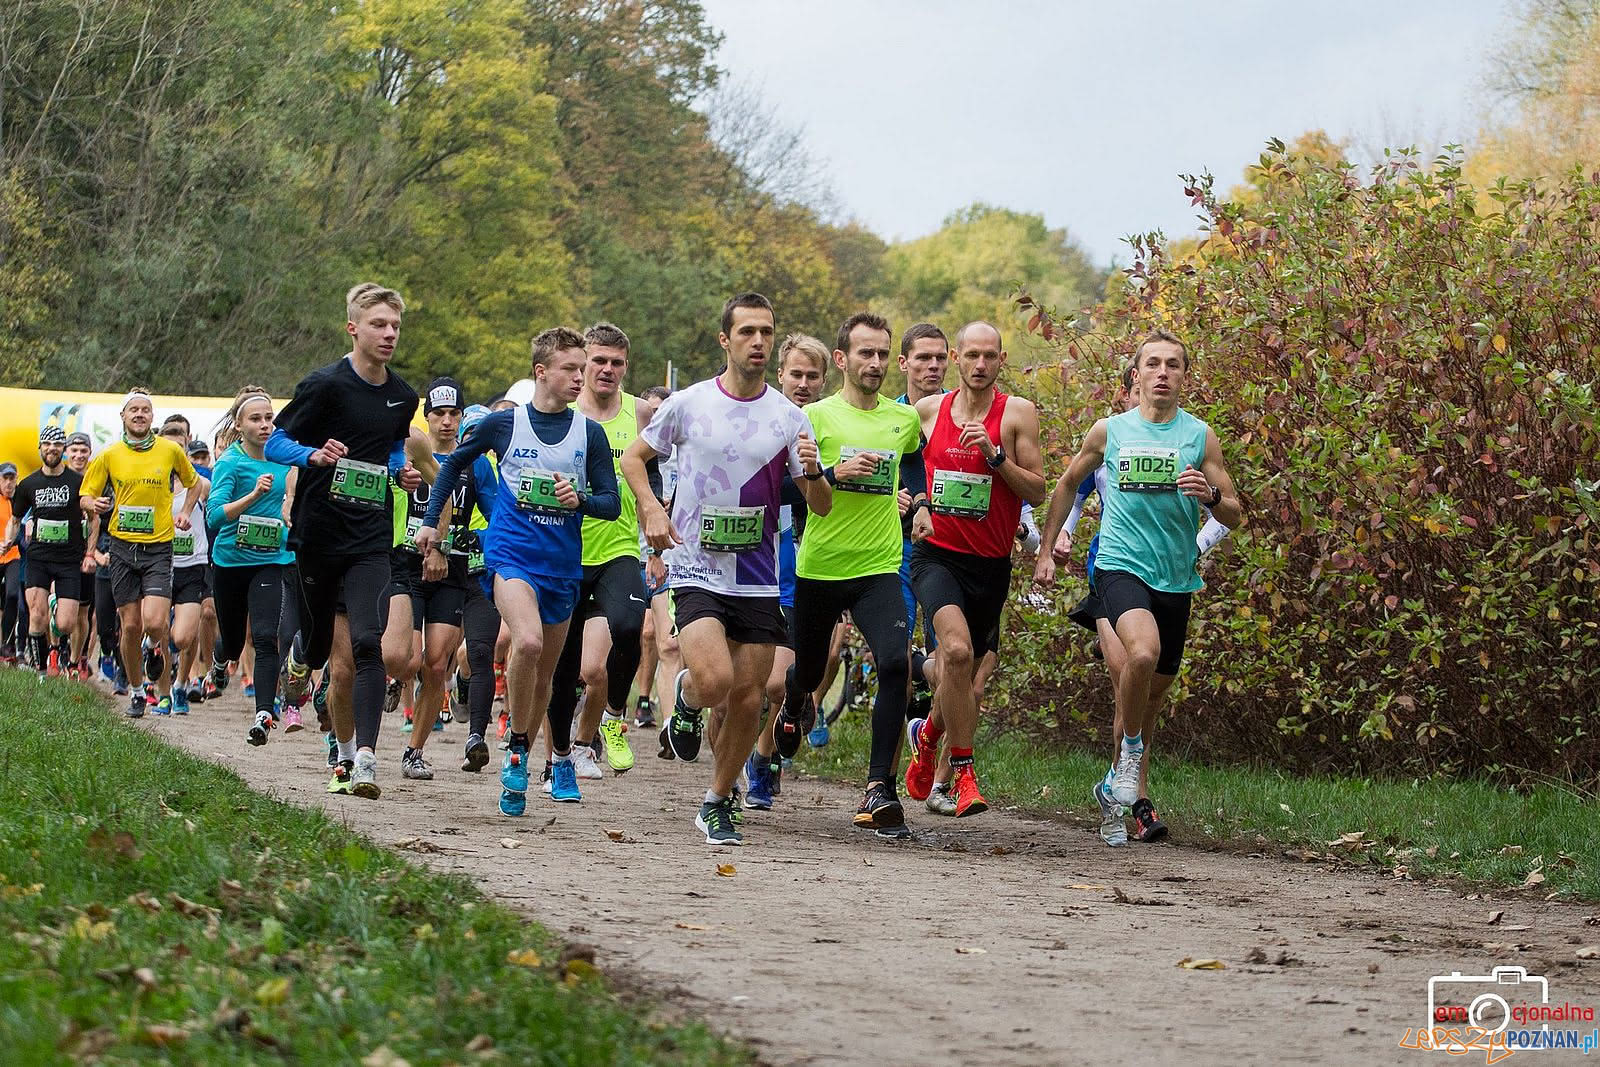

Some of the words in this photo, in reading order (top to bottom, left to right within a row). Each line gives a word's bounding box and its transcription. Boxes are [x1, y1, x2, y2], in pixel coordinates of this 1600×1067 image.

[512, 448, 539, 459] AZS
[871, 460, 890, 476] 95
[1134, 457, 1175, 473] 1025
[354, 472, 382, 491] 691
[539, 480, 557, 497] 62
[35, 491, 70, 505] SZPIKU
[960, 483, 973, 499] 2
[129, 512, 150, 523] 267
[52, 526, 59, 535] 5
[255, 525, 279, 539] 703
[721, 517, 758, 535] 1152
